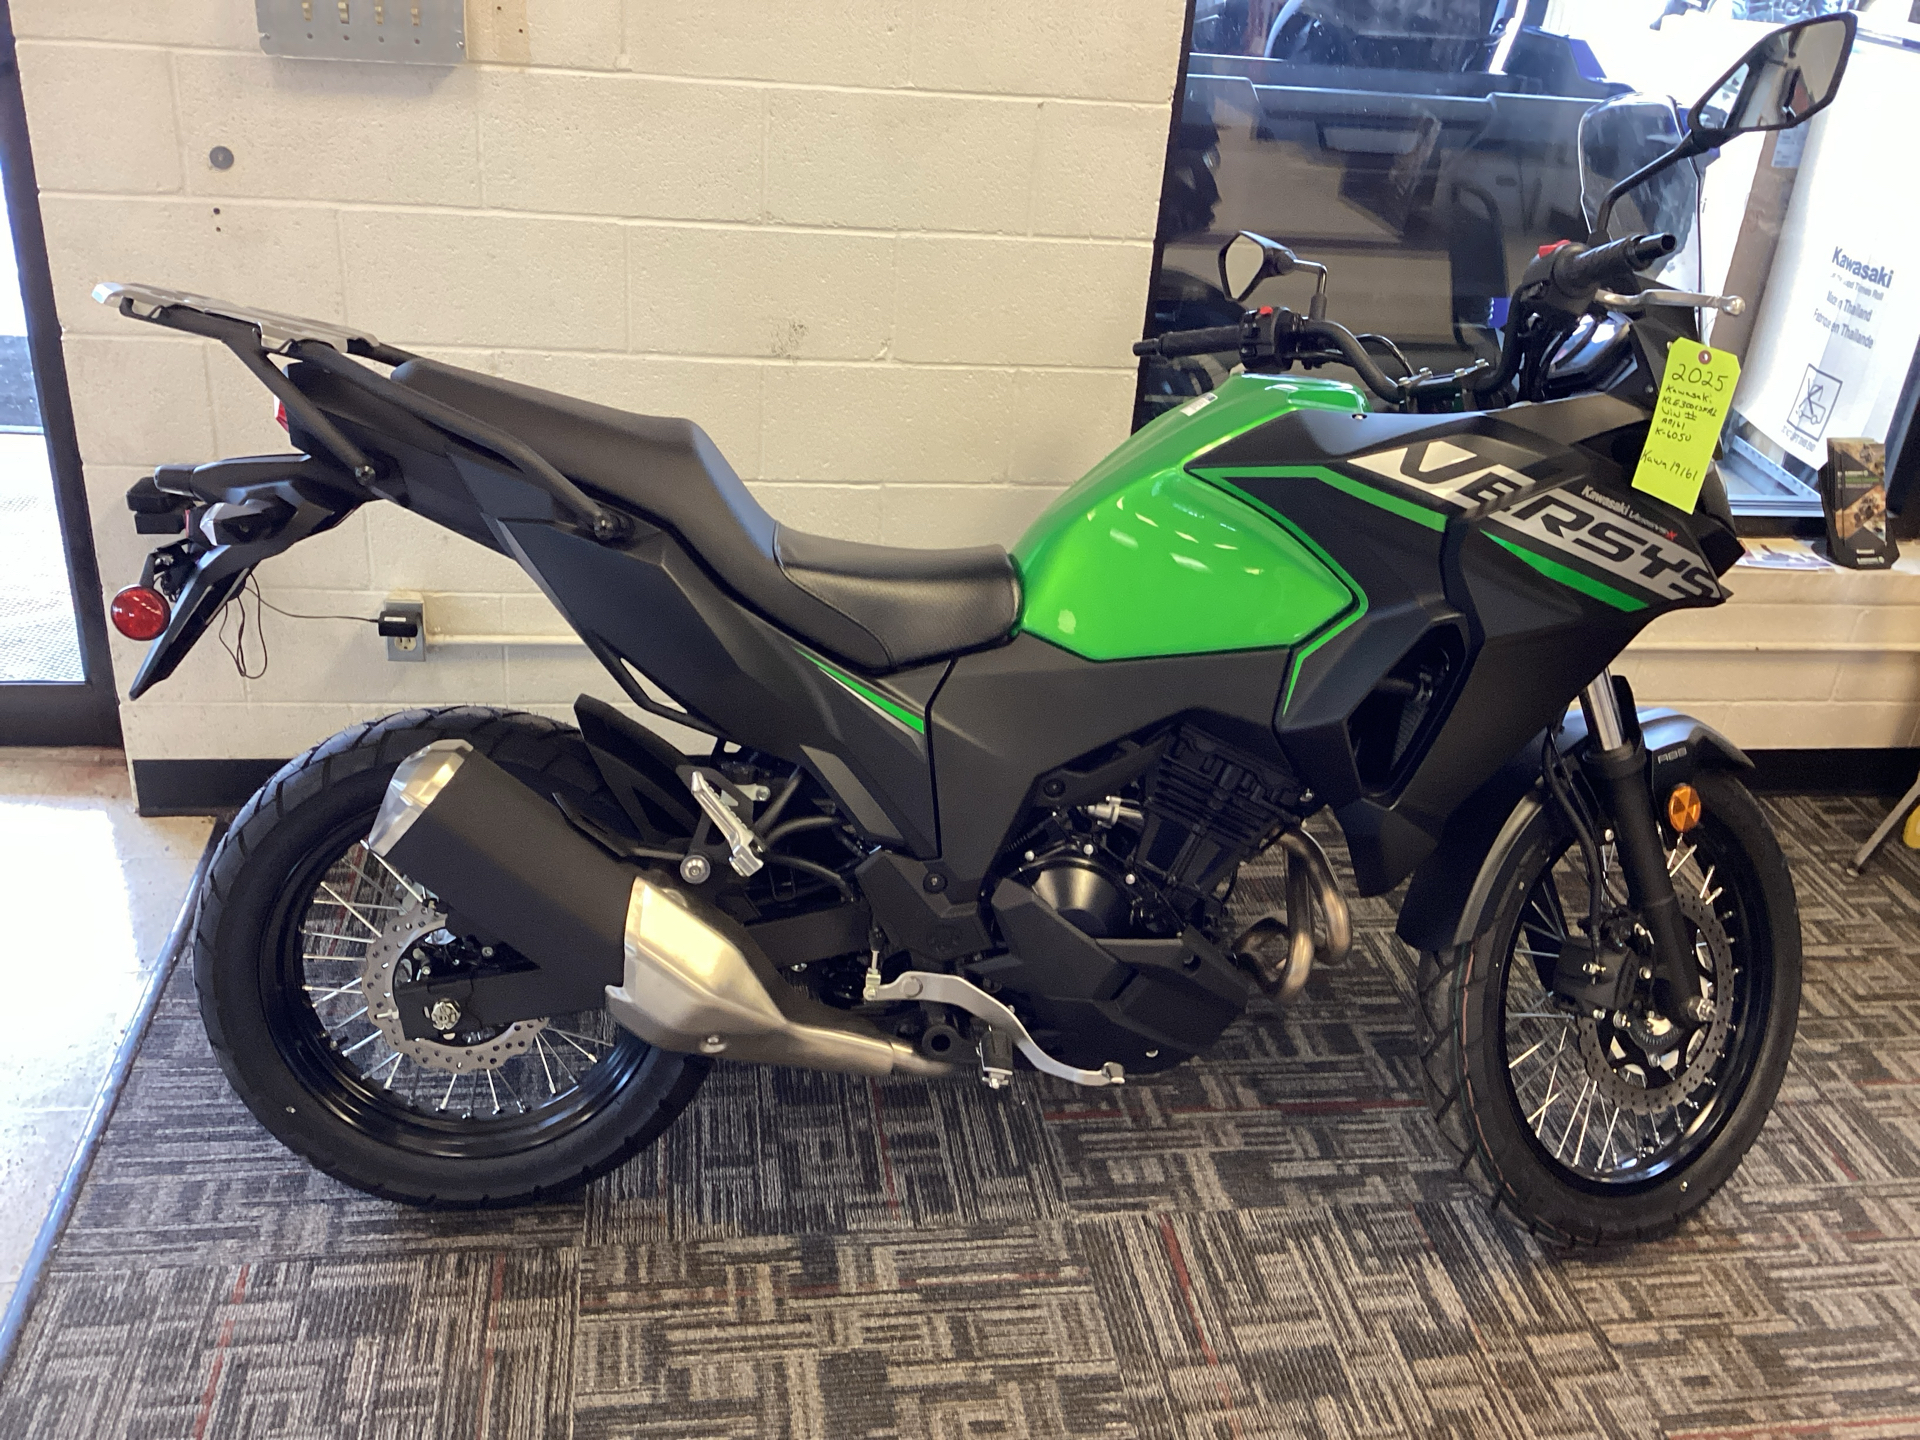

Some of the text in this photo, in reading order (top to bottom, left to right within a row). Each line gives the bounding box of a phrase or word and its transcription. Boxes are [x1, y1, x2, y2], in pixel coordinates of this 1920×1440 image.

[1831, 245, 1894, 289] Kawasaki
[1843, 298, 1873, 323] Thailand
[1831, 322, 1840, 334] en
[1671, 363, 1729, 392] 2025
[1665, 384, 1713, 404] Kawasaki
[1669, 460, 1698, 482] 19161
[1581, 484, 1631, 517] Kawasaki
[1396, 439, 1720, 602] VERSYS
